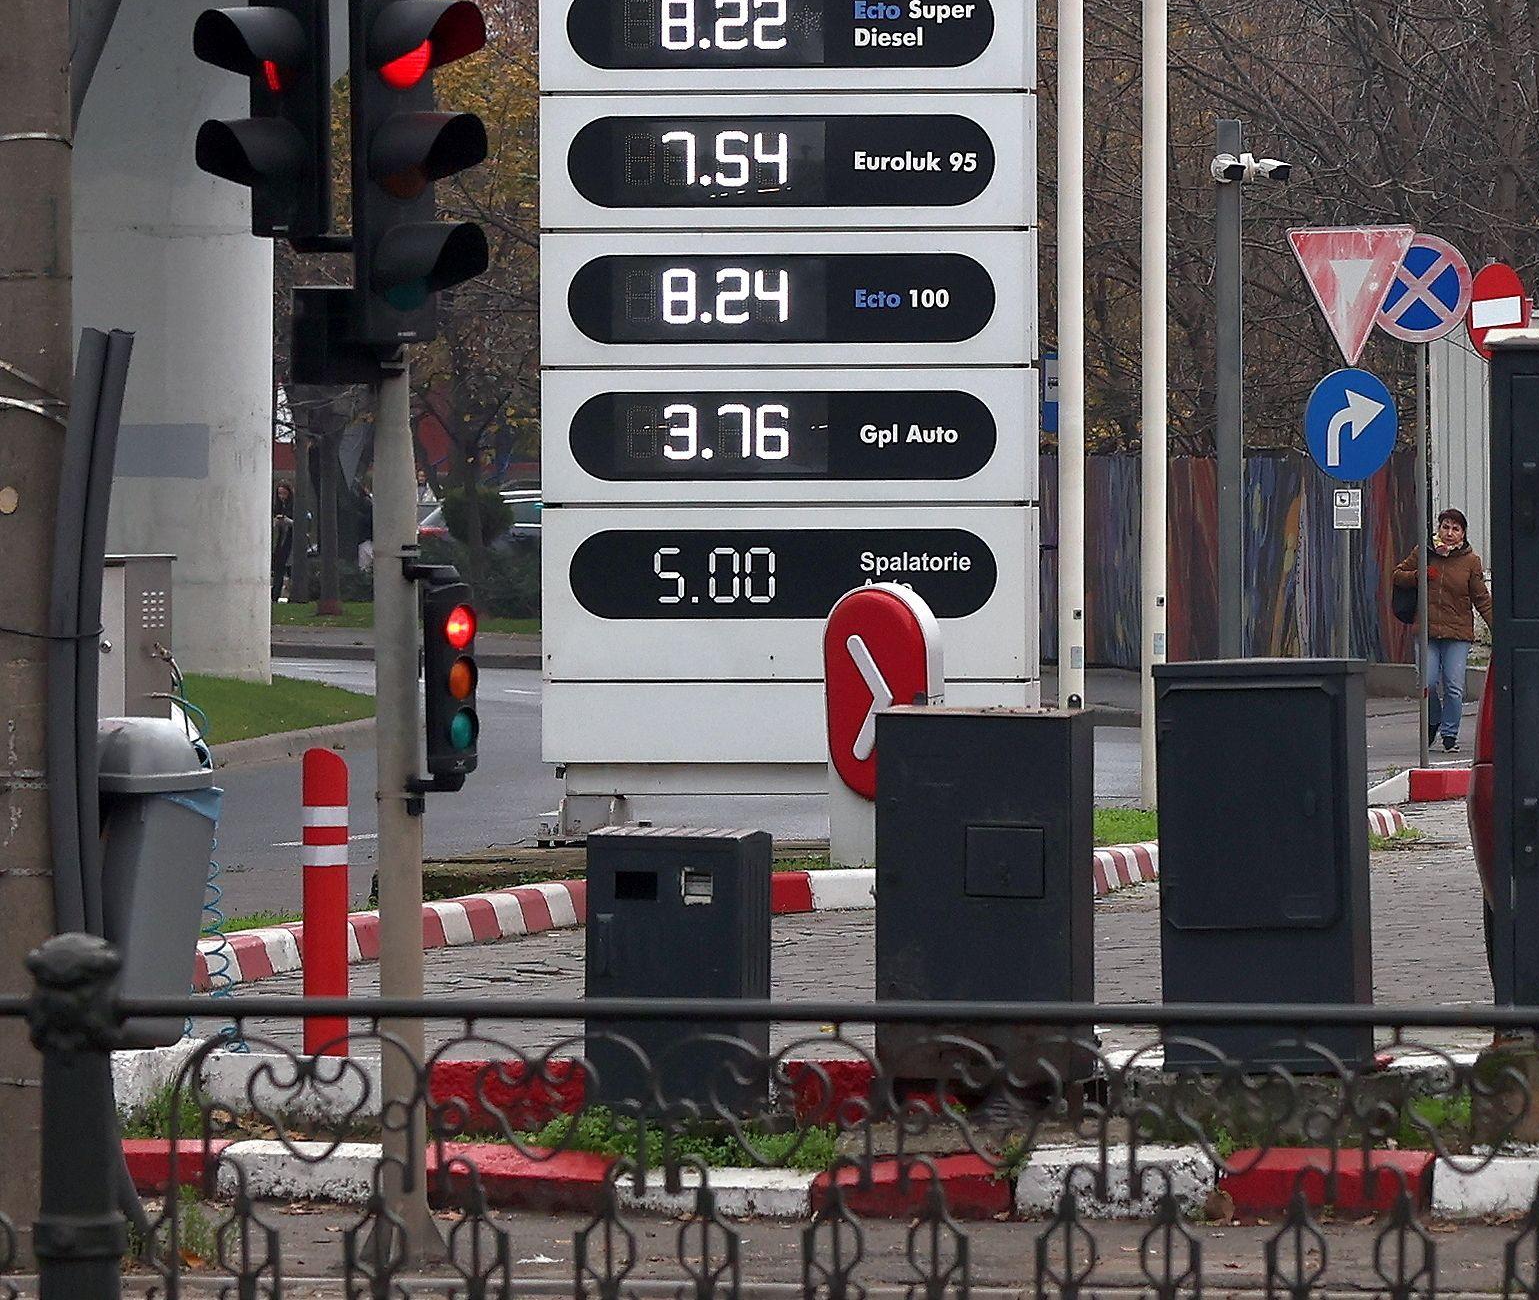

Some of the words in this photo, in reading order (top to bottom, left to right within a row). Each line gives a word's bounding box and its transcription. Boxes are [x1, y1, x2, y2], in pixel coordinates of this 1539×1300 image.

[855, 1, 901, 19] Ecto
[909, 0, 976, 23] Super
[855, 27, 924, 47] Diesel
[661, 130, 788, 187] 7.54
[855, 151, 942, 171] Euroluk
[950, 152, 977, 171] 95
[662, 267, 789, 325] 8.24
[855, 289, 901, 308] Ecto
[910, 289, 950, 307] 100
[663, 403, 790, 460] 3.76
[860, 424, 898, 447] Gpl
[906, 424, 959, 443] Auto
[653, 547, 776, 604] 5.00
[860, 552, 972, 576] Spalatorie
